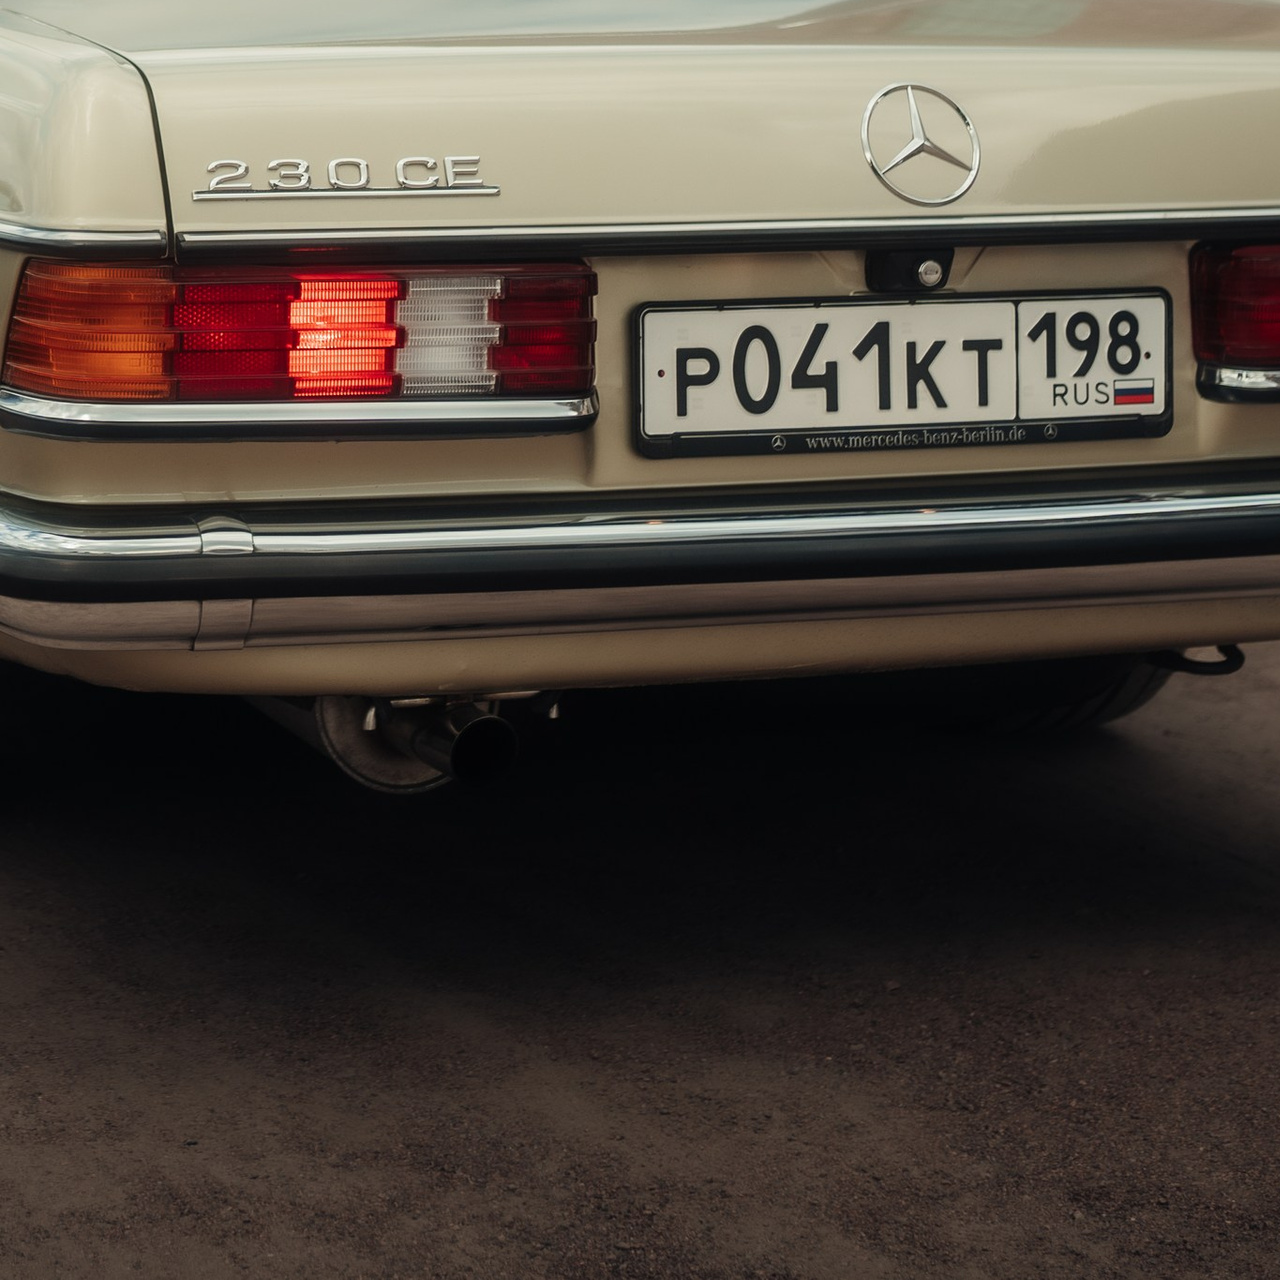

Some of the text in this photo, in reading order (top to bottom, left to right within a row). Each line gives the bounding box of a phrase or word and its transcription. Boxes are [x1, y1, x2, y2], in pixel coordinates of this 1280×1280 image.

[207, 156, 484, 191] 230 CE
[1027, 310, 1141, 378] 198
[1053, 382, 1110, 406] RUS
[806, 426, 1026, 449] www.mercedes-benz-berlin.de
